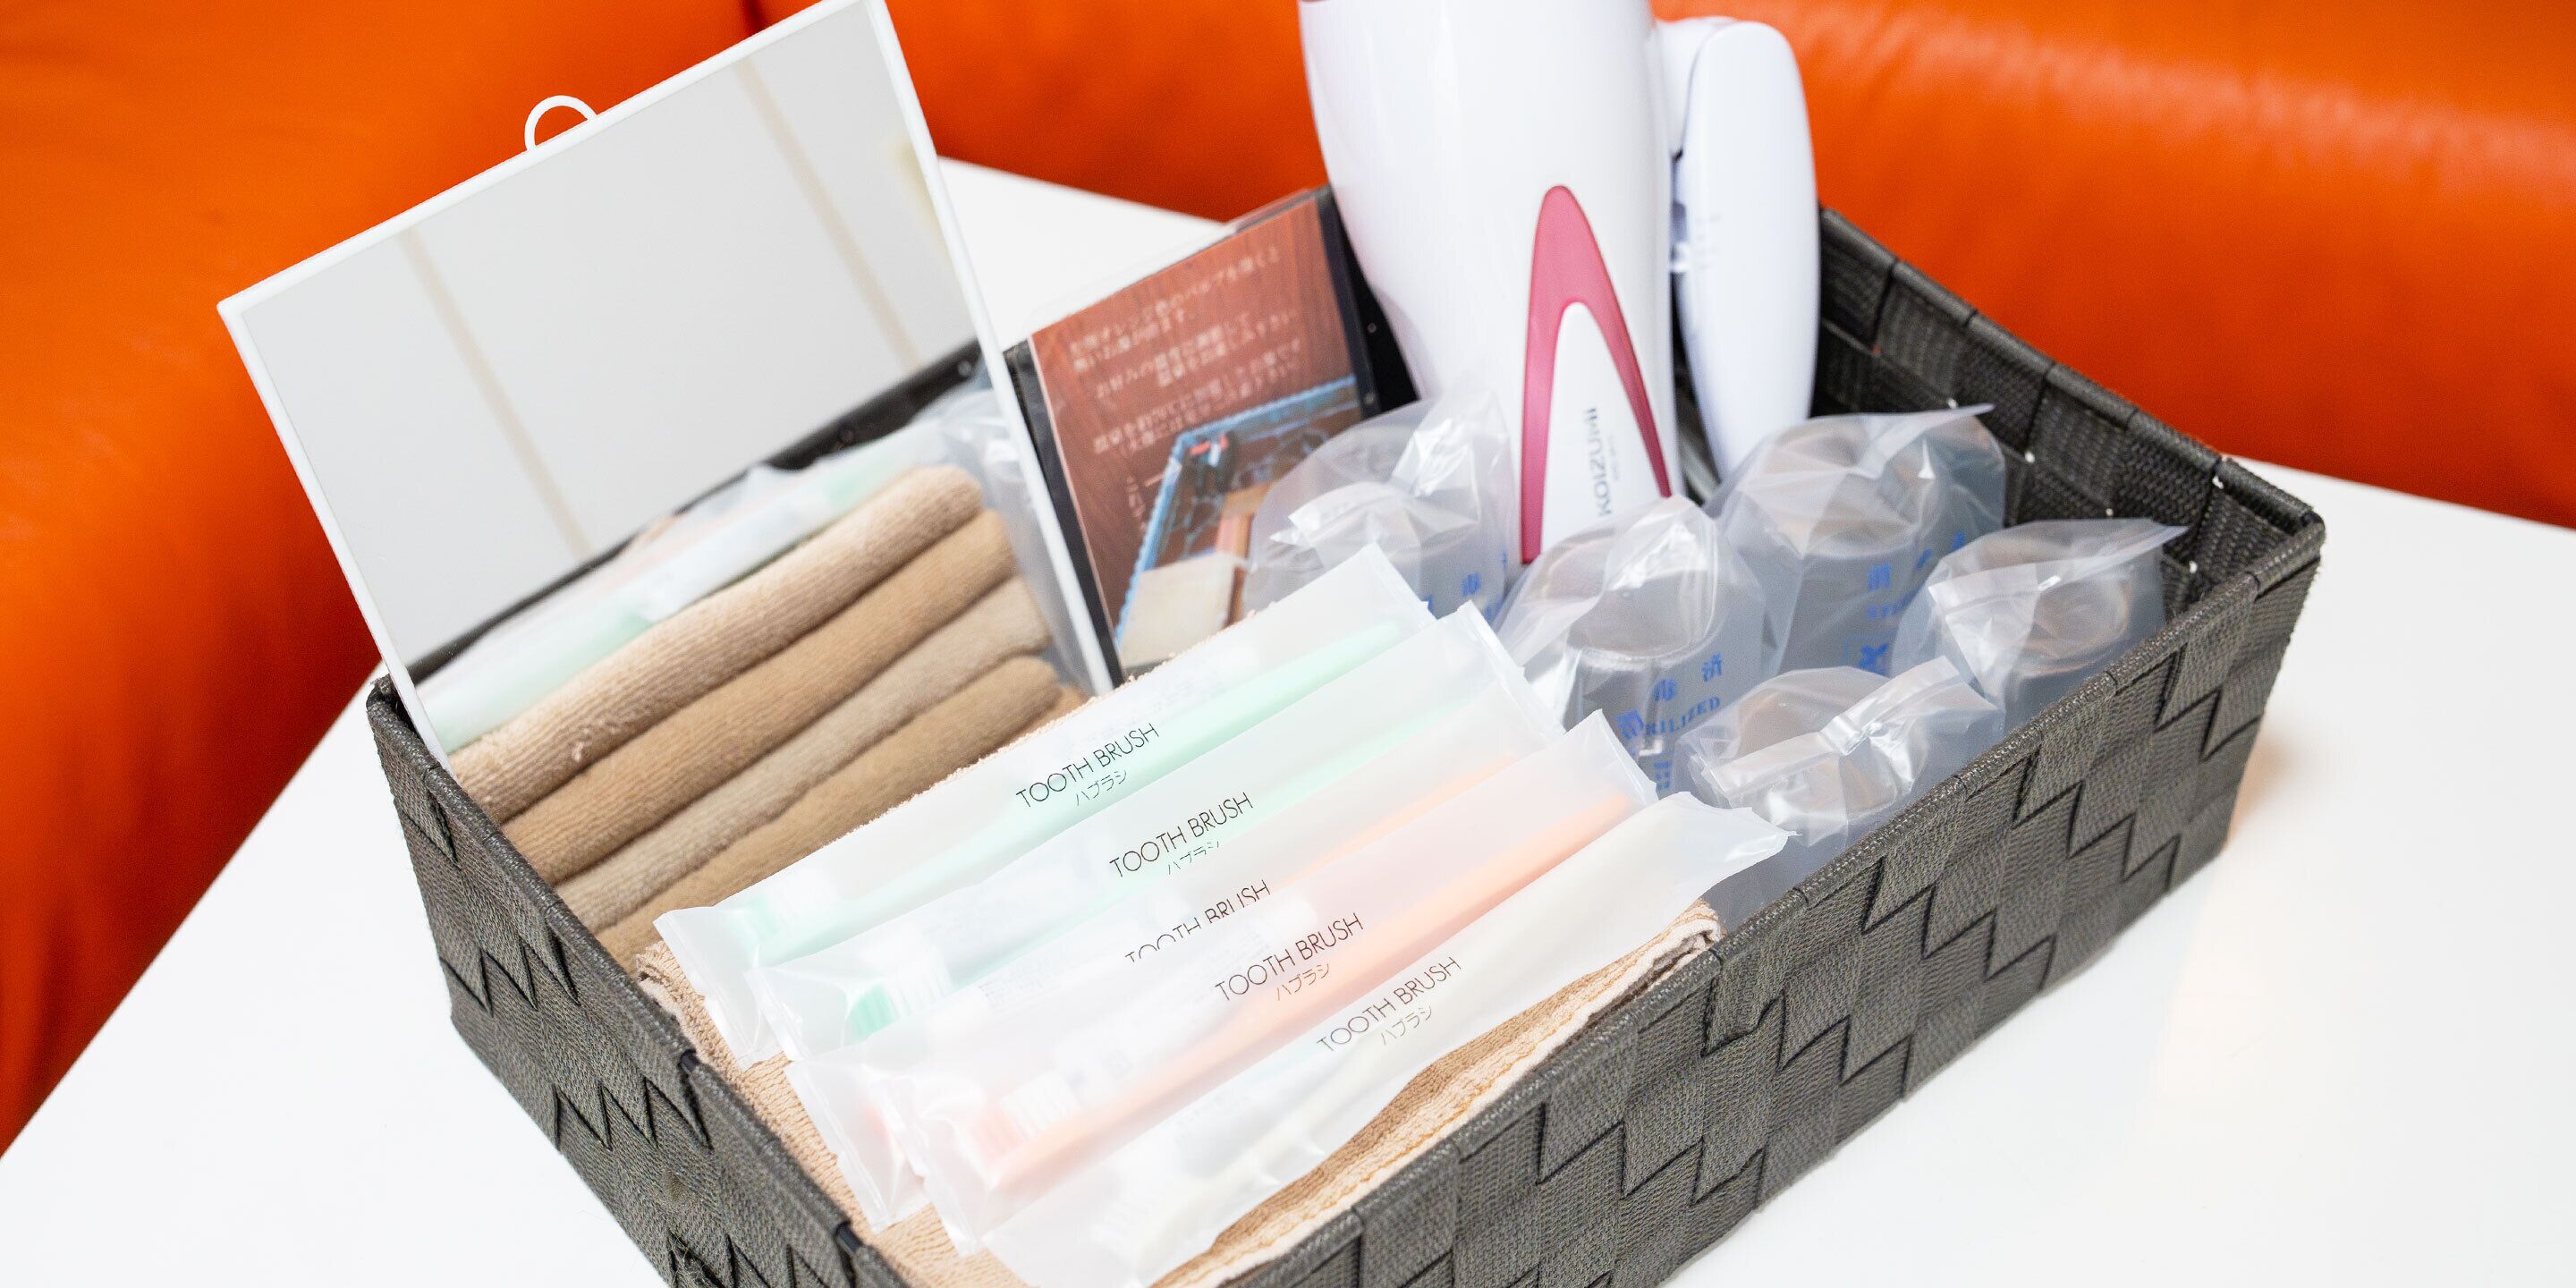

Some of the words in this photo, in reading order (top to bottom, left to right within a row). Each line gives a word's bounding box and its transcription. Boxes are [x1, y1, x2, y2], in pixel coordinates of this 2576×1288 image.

[1016, 758, 1094, 808] TOOTH
[1093, 723, 1159, 767] BRUSH
[1075, 769, 1127, 806] ハブラシ
[1109, 826, 1188, 877] TOOTH
[1187, 792, 1254, 838] BRUSH
[1215, 948, 1296, 1001] TOOTH
[1295, 912, 1364, 961] BRUSH
[1276, 963, 1330, 1001] ハブラシ
[1317, 997, 1396, 1052] TOOTH
[1394, 956, 1462, 1004] BRUSH
